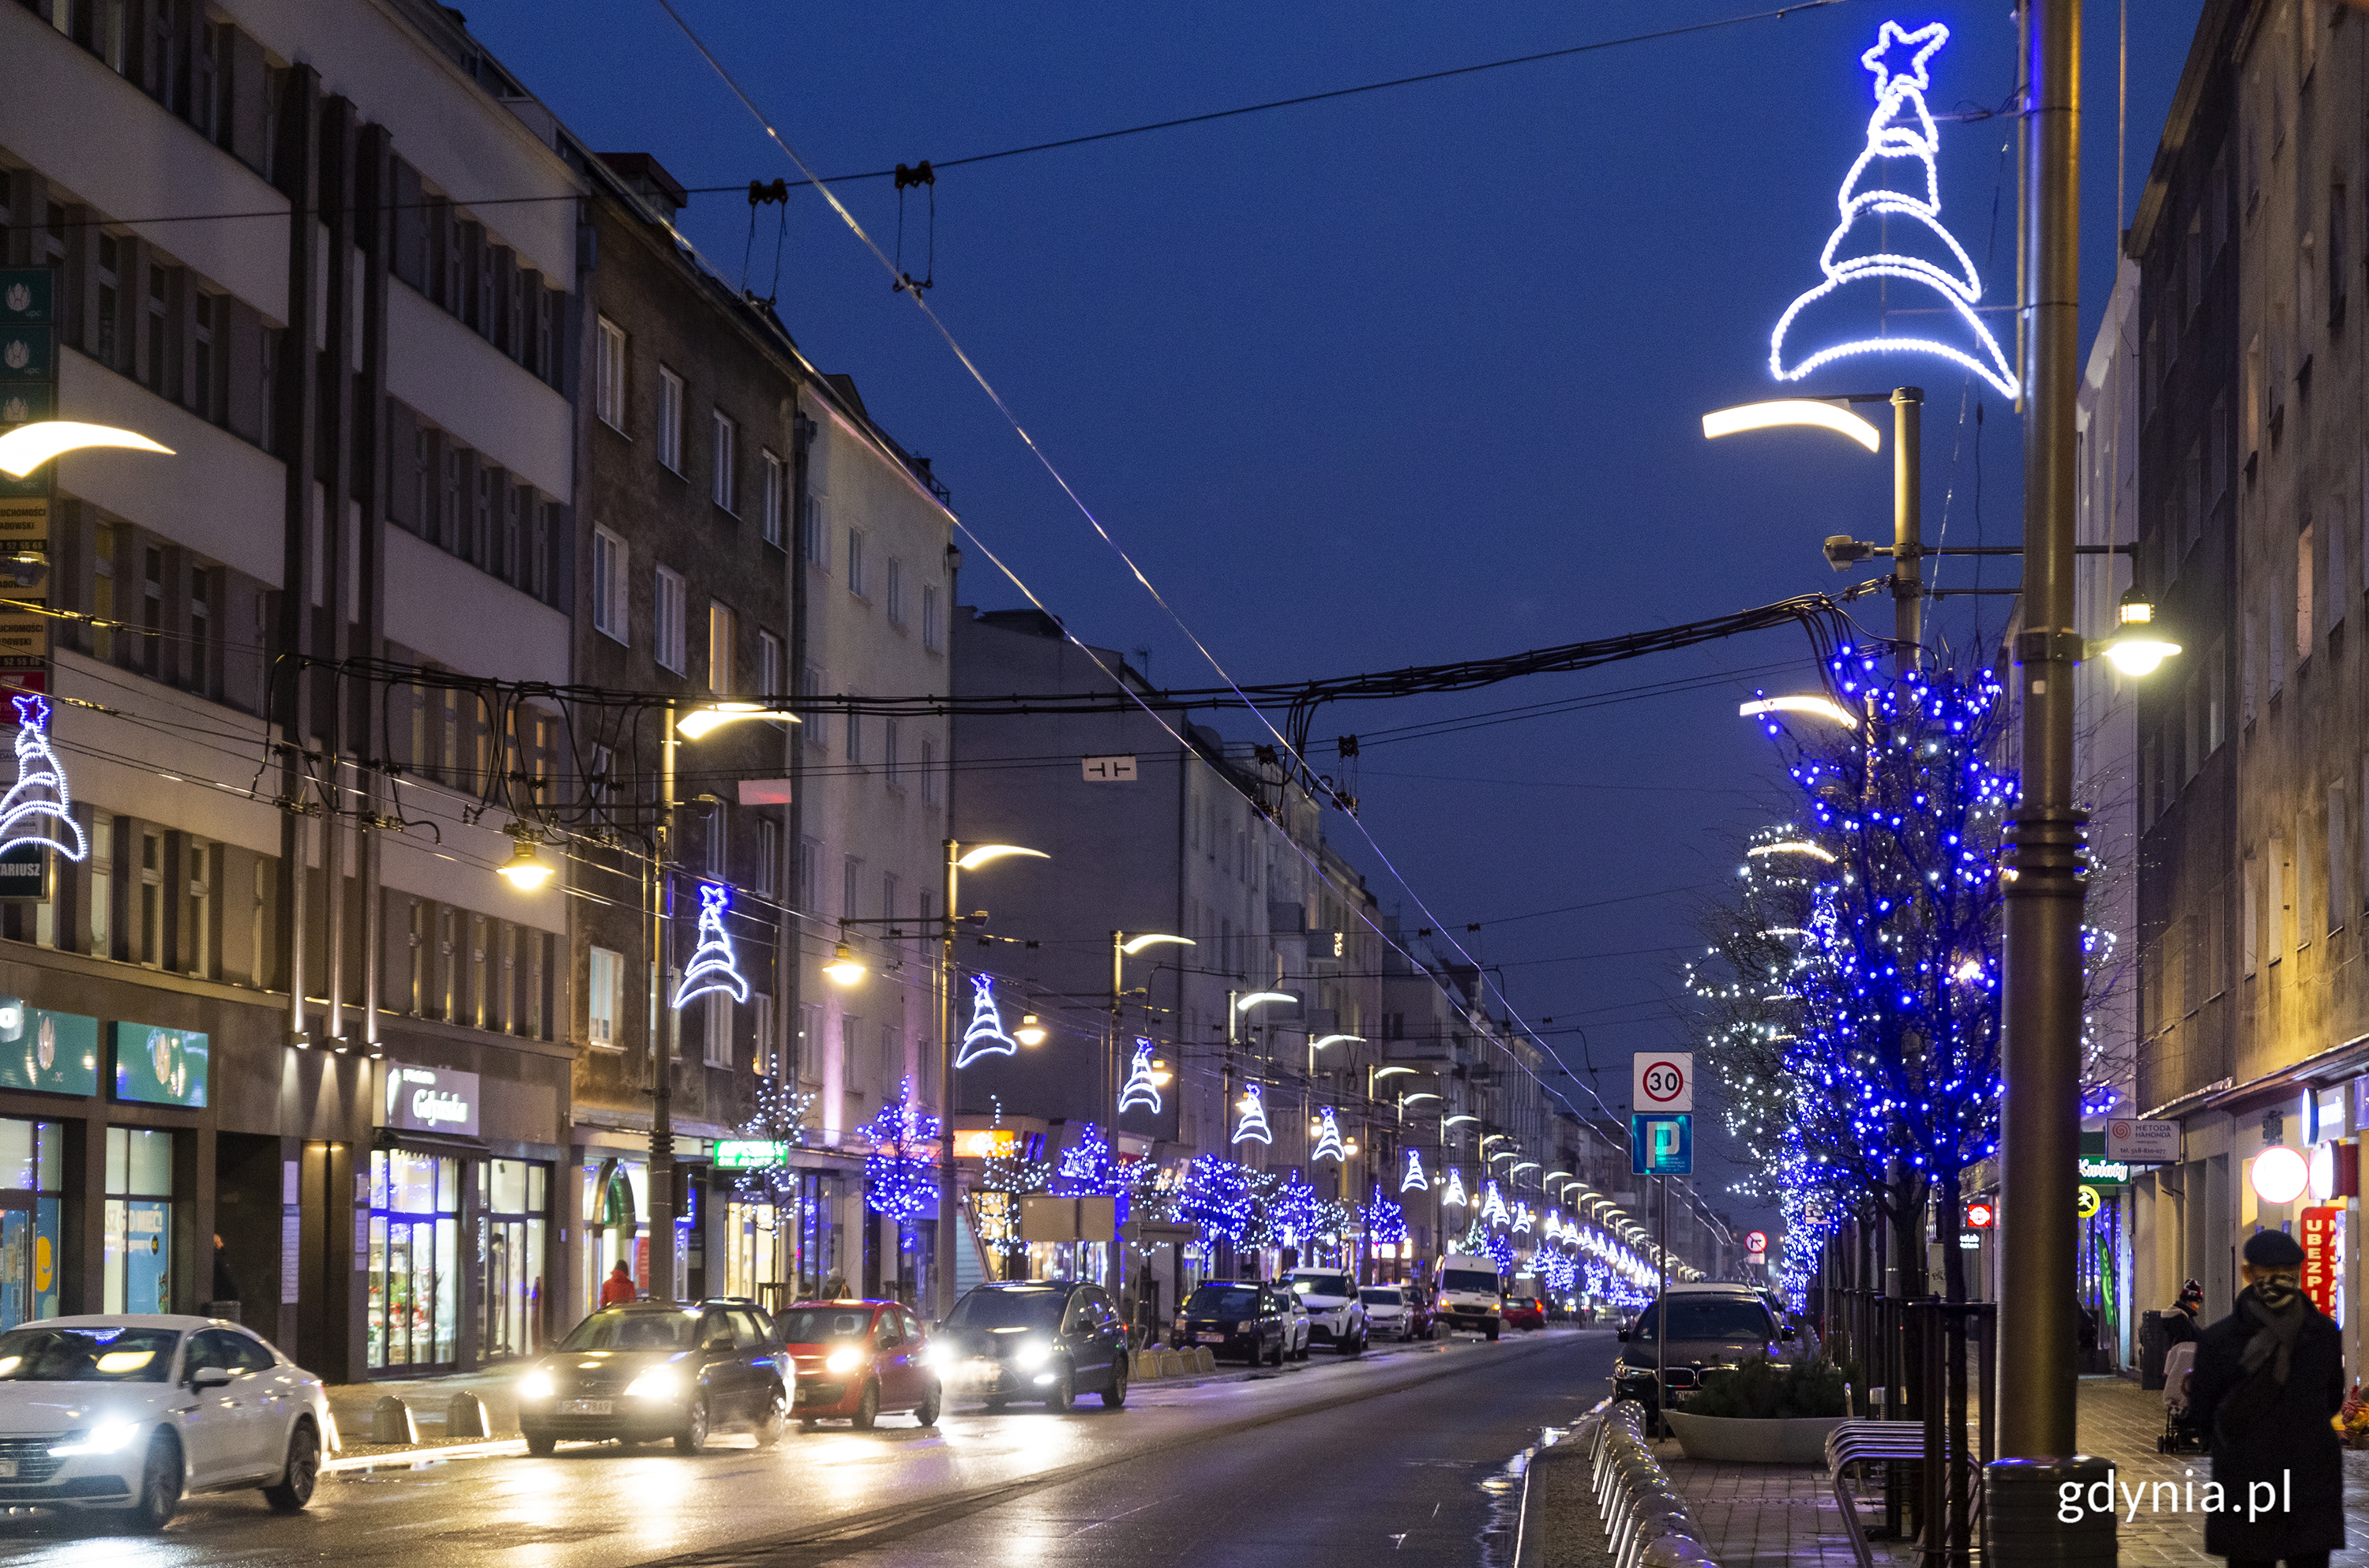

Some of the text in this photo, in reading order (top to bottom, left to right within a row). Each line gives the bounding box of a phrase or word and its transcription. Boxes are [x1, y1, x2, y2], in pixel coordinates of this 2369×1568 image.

[25, 309, 42, 319] upc
[0, 506, 46, 517] UCHOMOŚCI
[0, 863, 40, 876] ARIUSZ
[1649, 1072, 1678, 1091] 30
[1646, 1121, 1680, 1168] P
[2078, 1158, 2129, 1182] Kwiaty
[2306, 1219, 2323, 1311] UBEZPI
